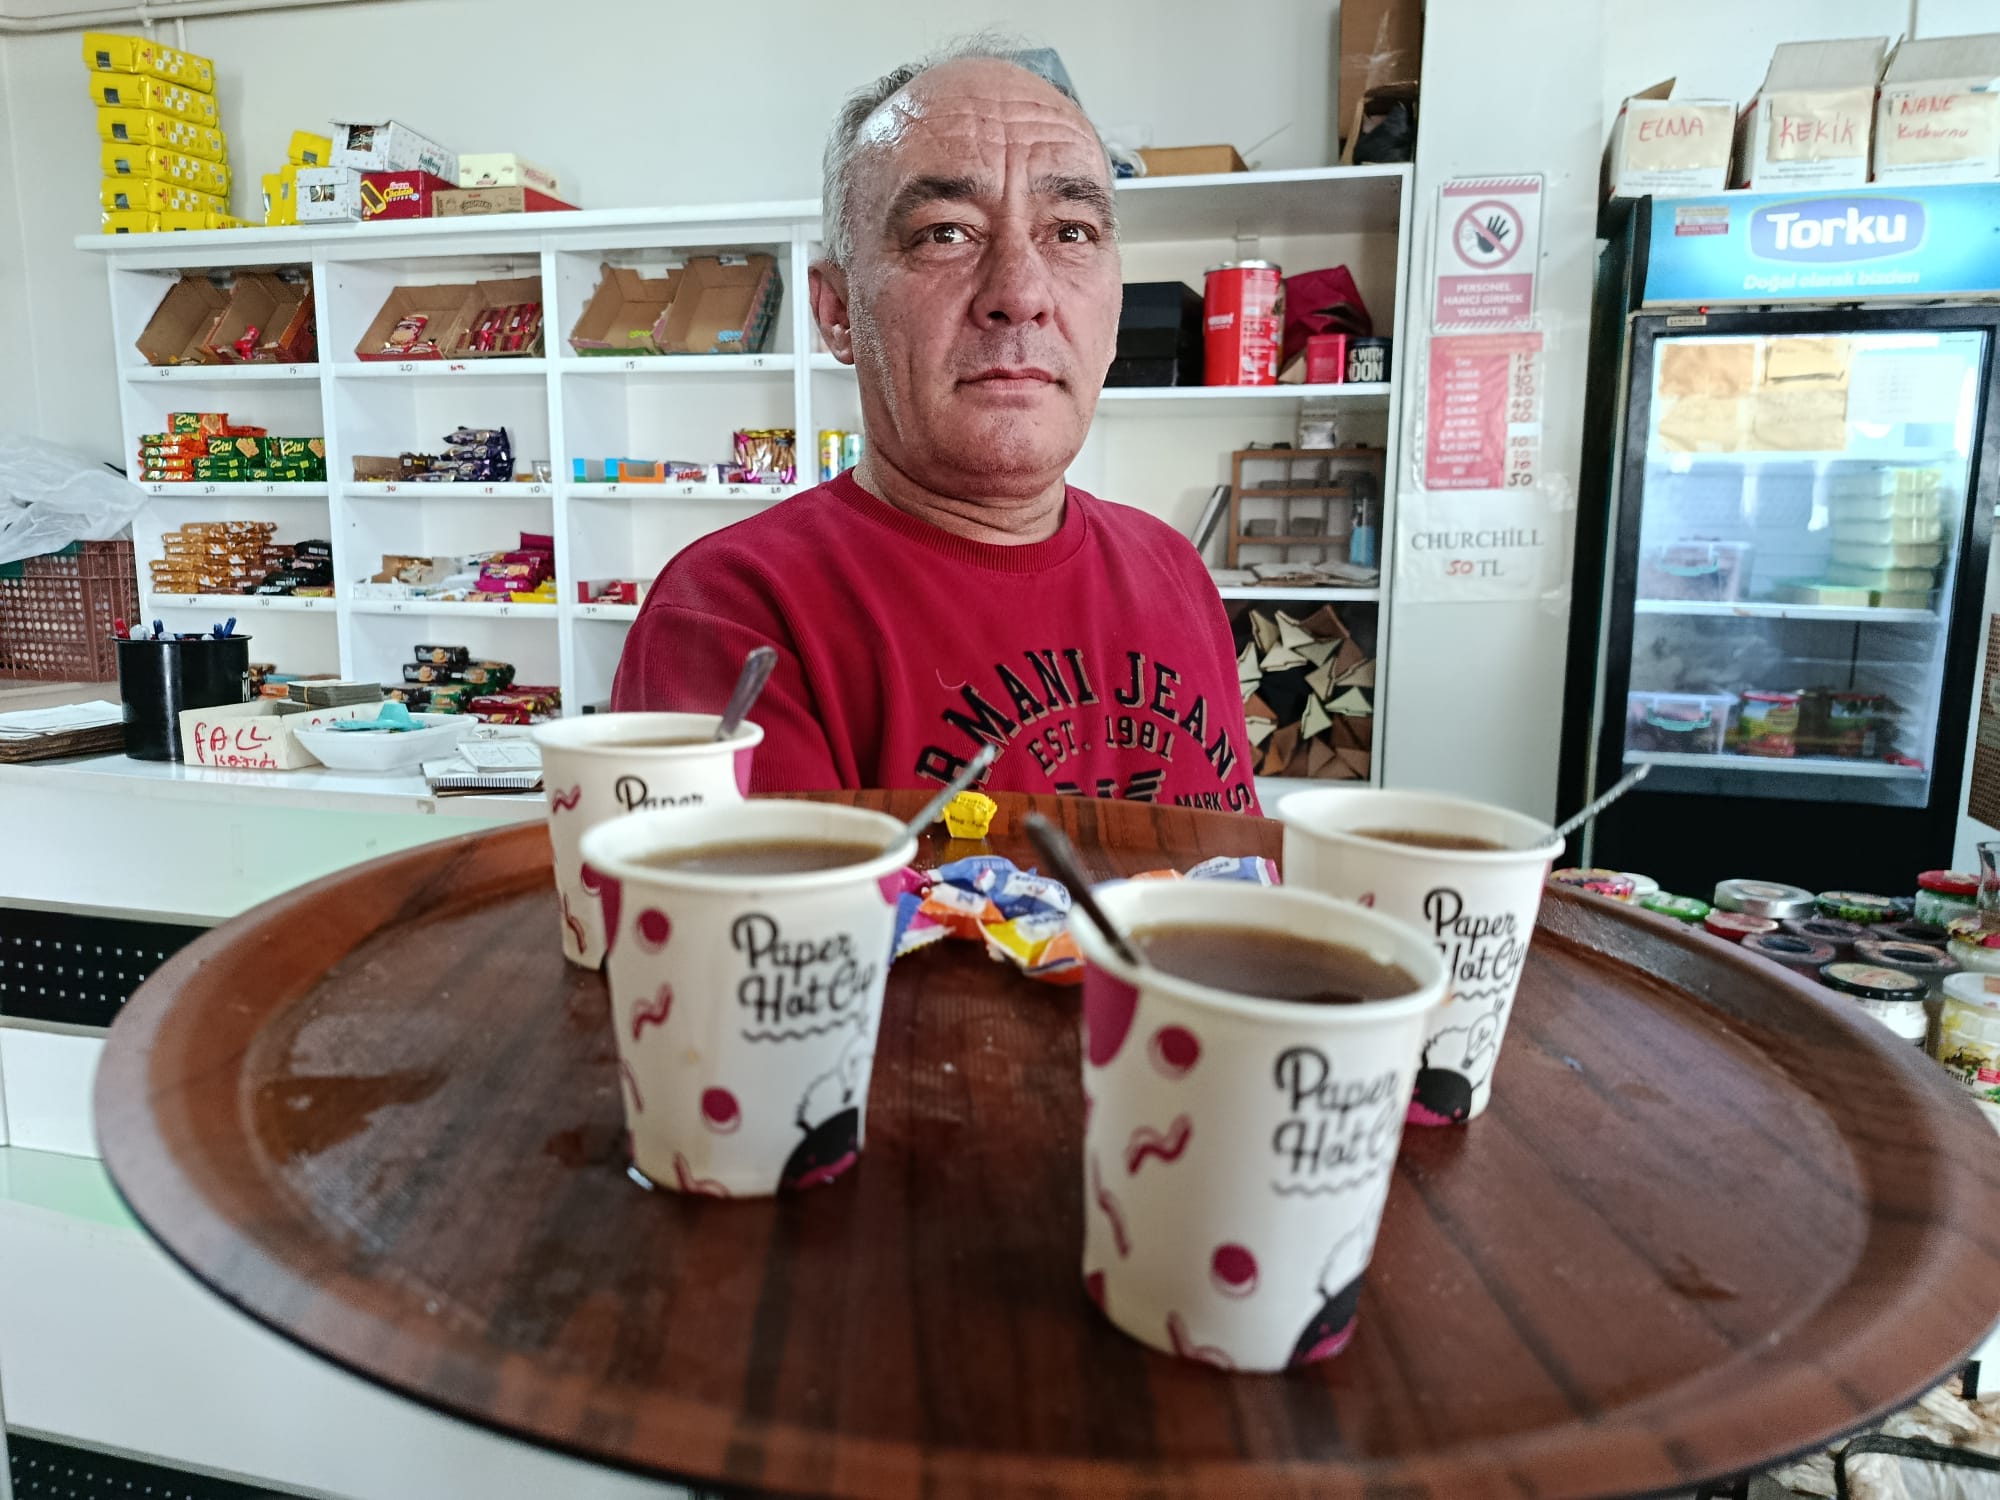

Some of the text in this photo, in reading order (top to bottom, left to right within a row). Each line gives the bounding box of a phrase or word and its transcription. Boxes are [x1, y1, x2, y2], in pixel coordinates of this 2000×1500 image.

[1638, 115, 1704, 142] ELMA
[1766, 207, 1907, 251] Torku
[1456, 282, 1511, 293] PERSONEL
[1358, 347, 1384, 361] WITH
[1507, 472, 1533, 487] 50
[1411, 527, 1545, 551] CHURCHİLL
[1445, 559, 1505, 577] 50 TL
[914, 648, 1254, 814] RMANI JEANS
[1028, 714, 1176, 778] EST. 1981
[1423, 887, 1517, 955] Paper
[730, 912, 855, 988] Paper
[738, 972, 826, 1024] Hot
[1272, 1046, 1398, 1134] Paper
[1271, 1117, 1364, 1176] Hot
